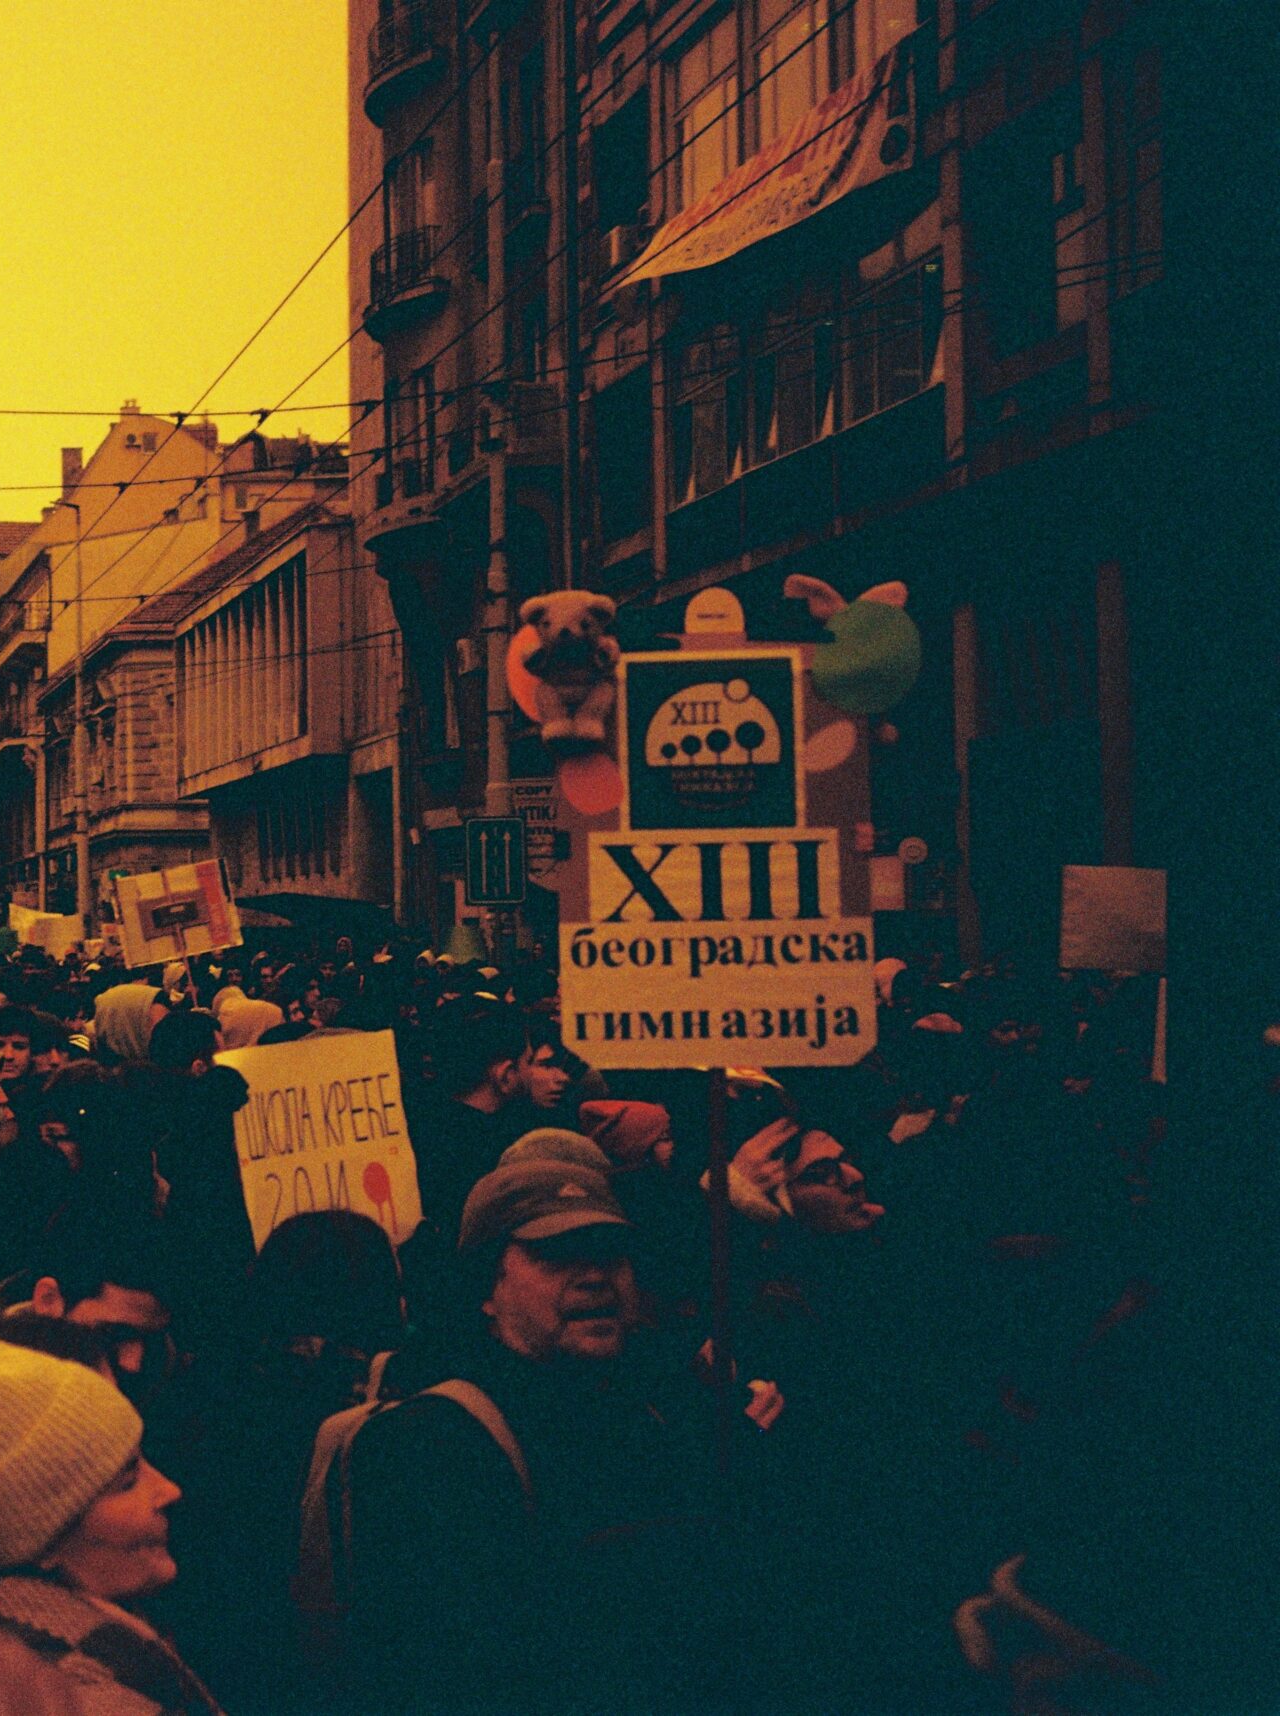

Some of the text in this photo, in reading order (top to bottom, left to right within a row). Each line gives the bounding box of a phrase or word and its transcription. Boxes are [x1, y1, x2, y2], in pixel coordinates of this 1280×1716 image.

[669, 701, 721, 726] XIII
[515, 786, 553, 795] COPY
[599, 840, 829, 923] XIII
[570, 929, 870, 978] београдска
[574, 994, 860, 1050] гимназија
[320, 1073, 400, 1148] КРЕЋЕ
